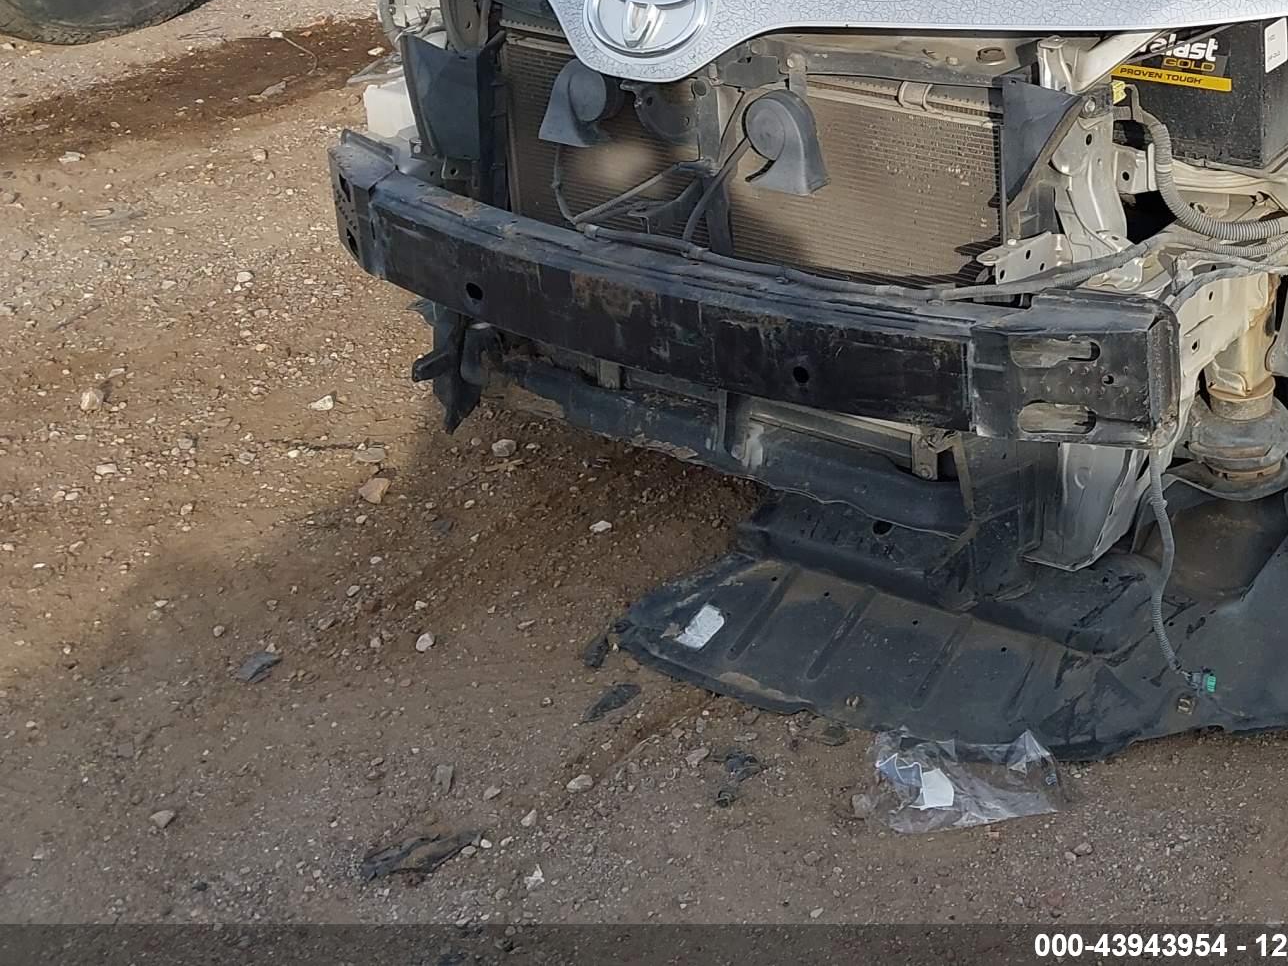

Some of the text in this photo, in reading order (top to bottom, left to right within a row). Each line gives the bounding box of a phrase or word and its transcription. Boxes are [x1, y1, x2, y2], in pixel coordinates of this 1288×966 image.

[1162, 57, 1216, 72] GOLD
[1119, 67, 1203, 85] PROVEN TOUGH
